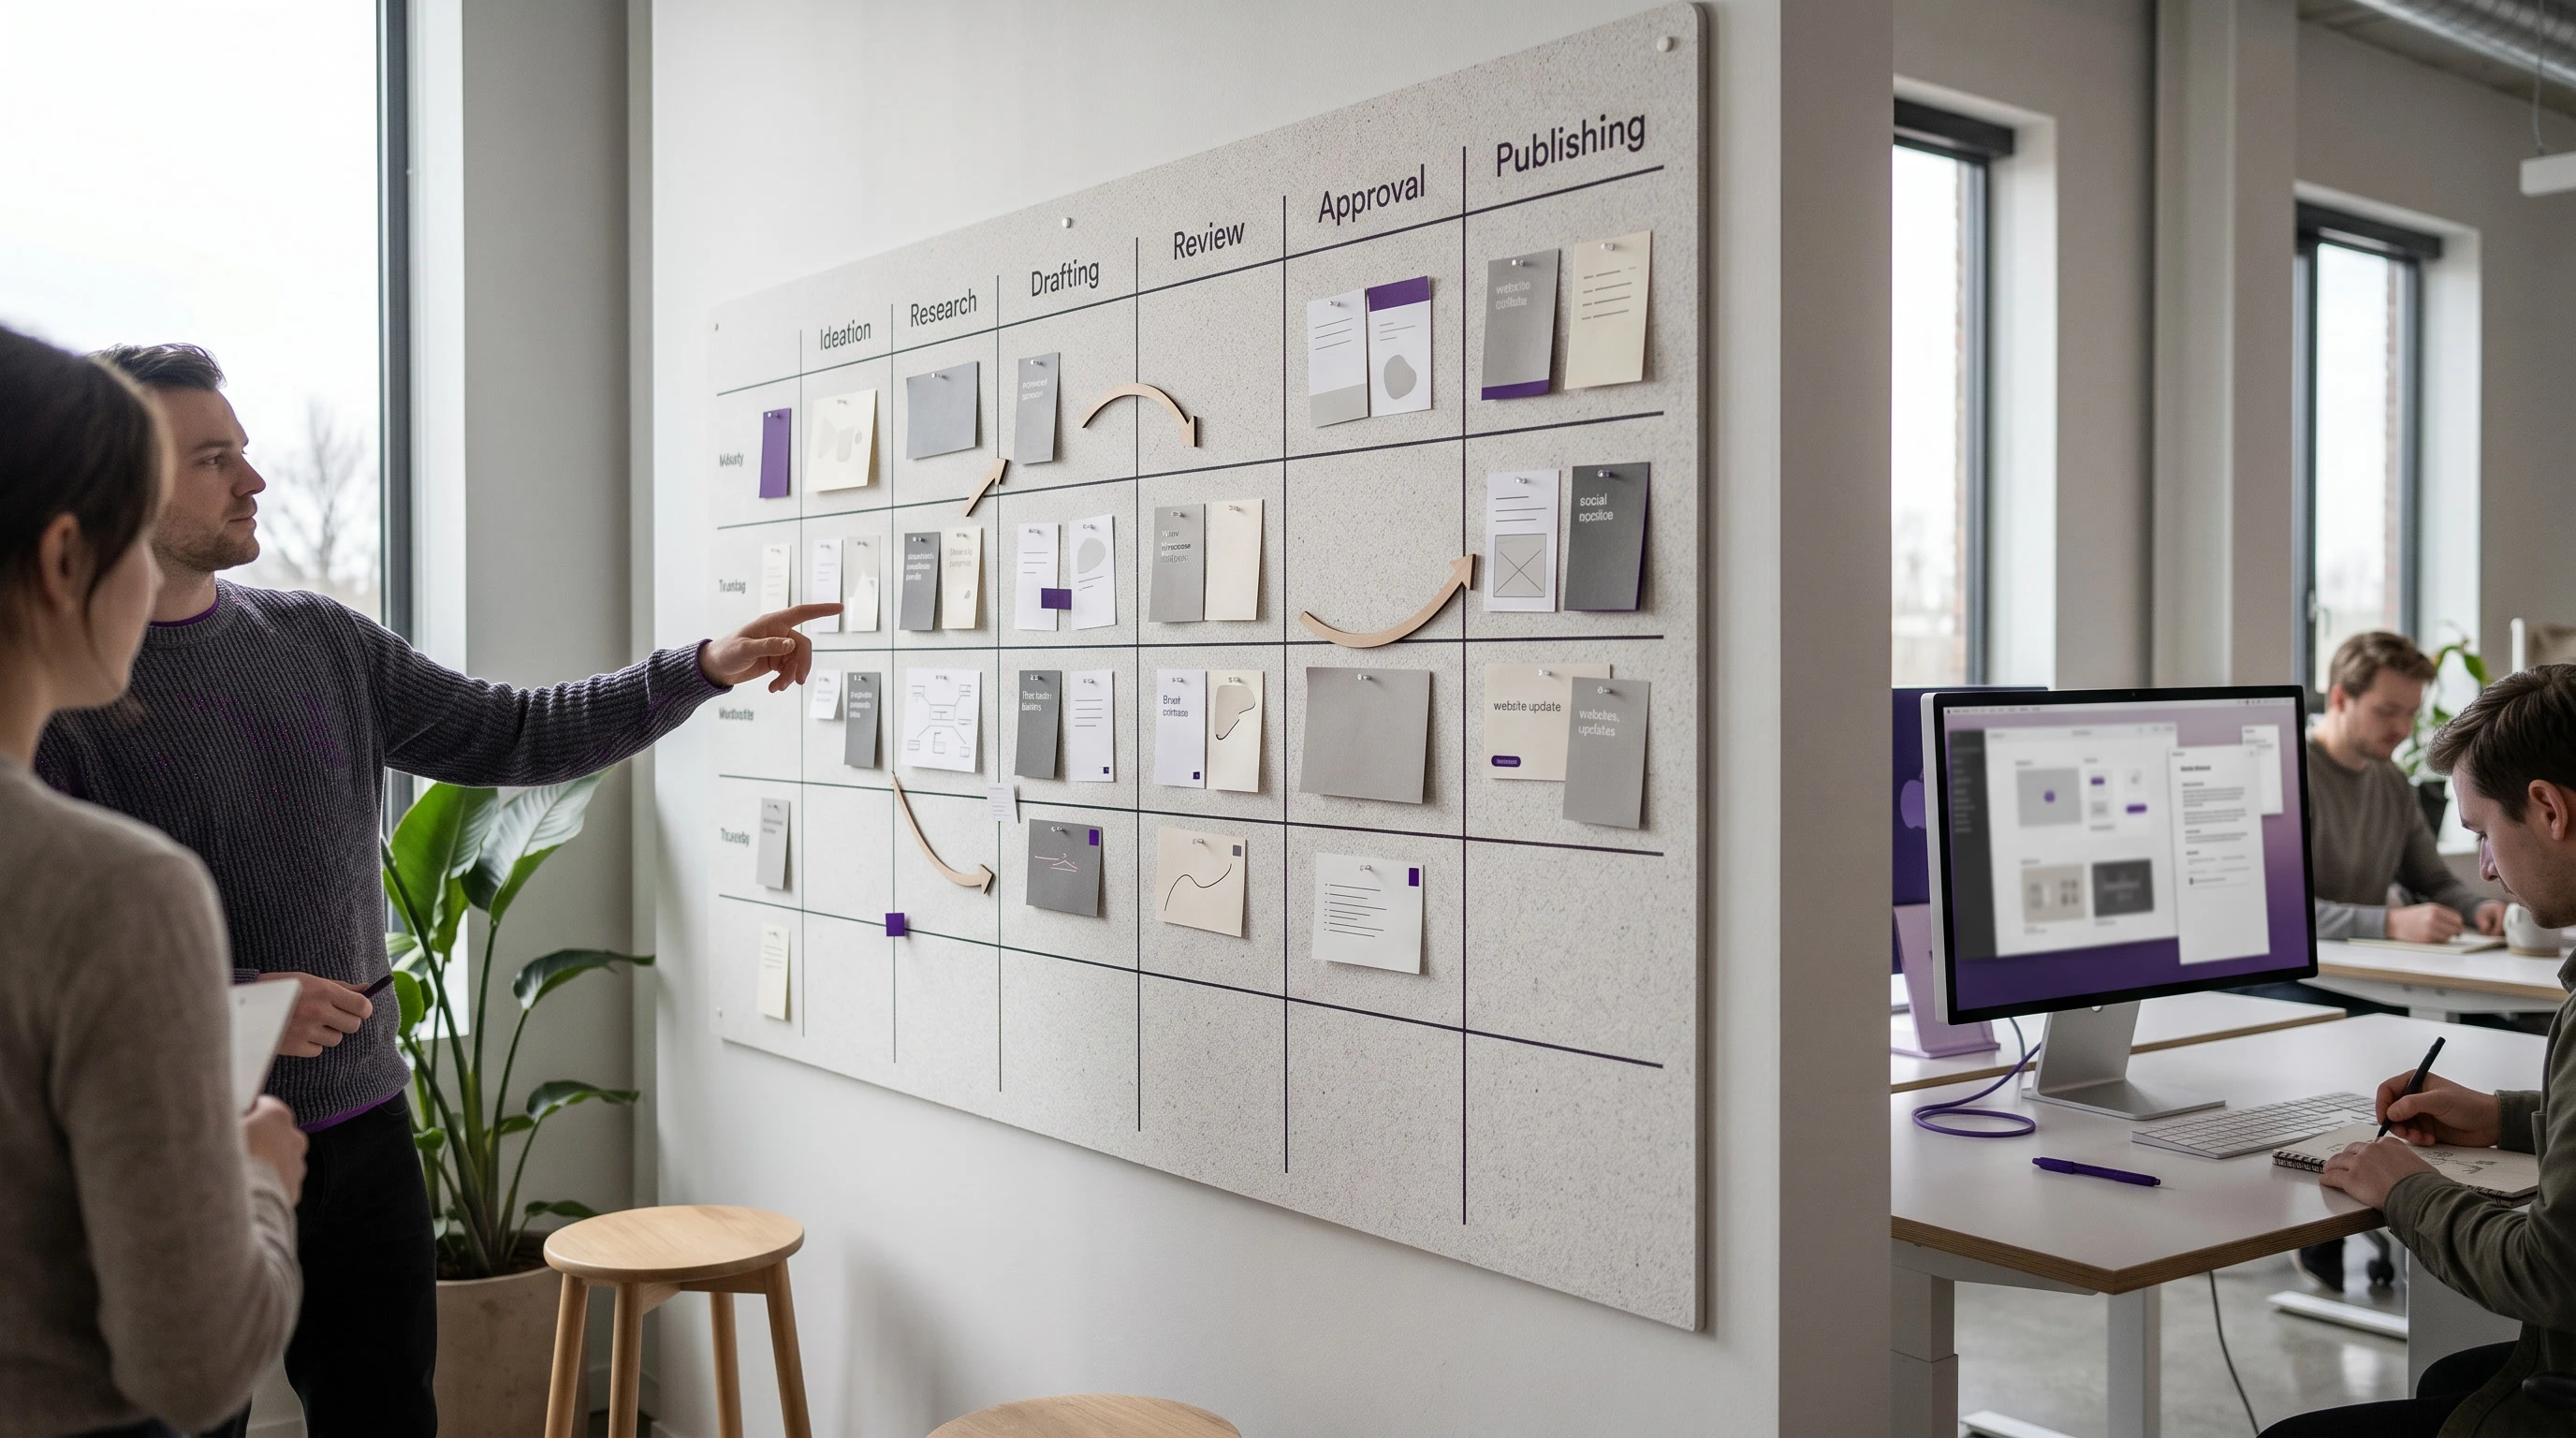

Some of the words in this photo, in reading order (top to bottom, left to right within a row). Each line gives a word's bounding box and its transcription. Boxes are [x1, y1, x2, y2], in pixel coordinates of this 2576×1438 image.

[1497, 113, 1645, 177] Publishing
[1318, 163, 1425, 227] Approval
[1174, 222, 1245, 260] Review
[1031, 258, 1100, 297] Drafting
[911, 287, 977, 328] Research
[820, 319, 871, 350] Ideation
[1579, 492, 1607, 506] social
[1494, 700, 1527, 712] website
[1529, 701, 1561, 713] update
[1578, 724, 1616, 737] updates
